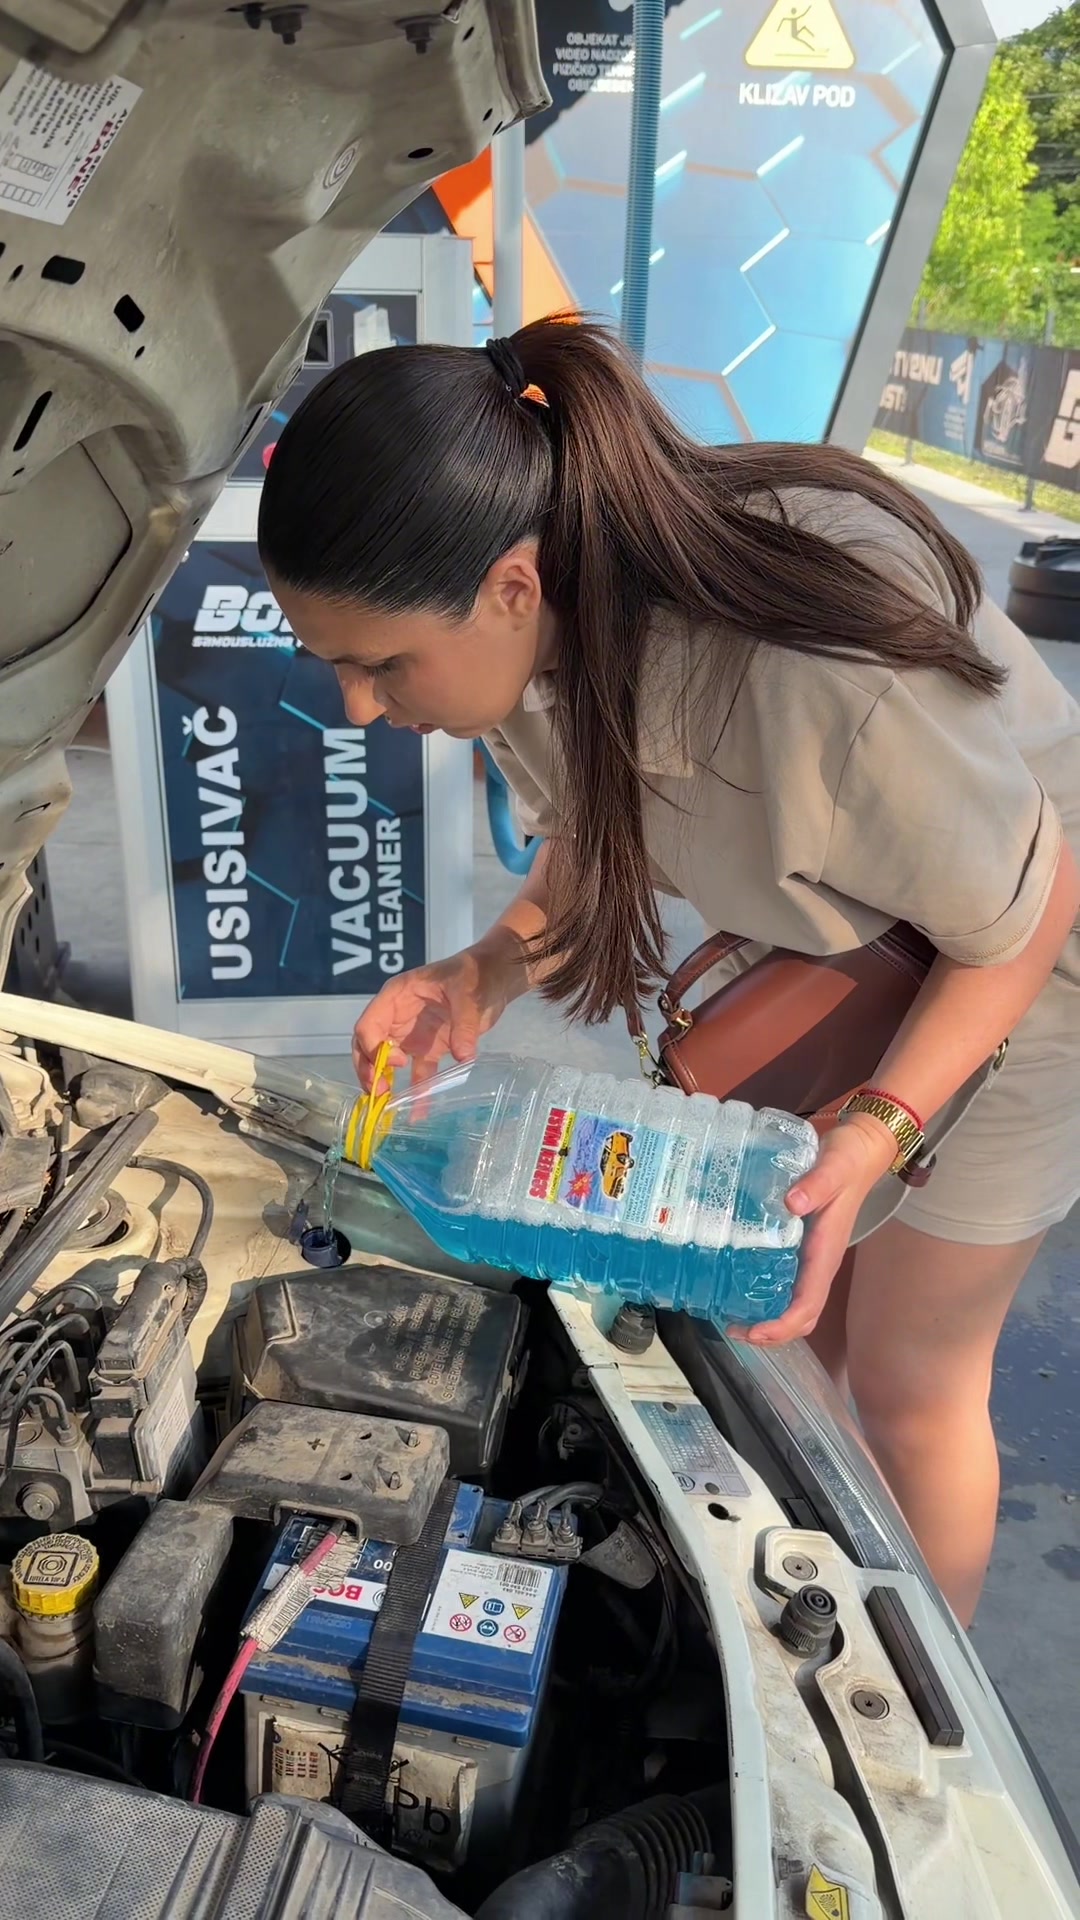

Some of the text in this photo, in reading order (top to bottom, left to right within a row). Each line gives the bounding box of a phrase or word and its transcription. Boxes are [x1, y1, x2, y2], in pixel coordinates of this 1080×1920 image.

[739, 82, 856, 108] KLIZAV POD
[102, 108, 128, 150] AUTO
[67, 155, 102, 208] SERVIS
[181, 705, 254, 981] USISIVAČ
[322, 727, 372, 977] VACUUM
[376, 816, 405, 975] CLEANER
[529, 1107, 566, 1199] SCREEN WASH
[410, 1351, 429, 1379] FUSES
[394, 1785, 451, 1836] Pb
